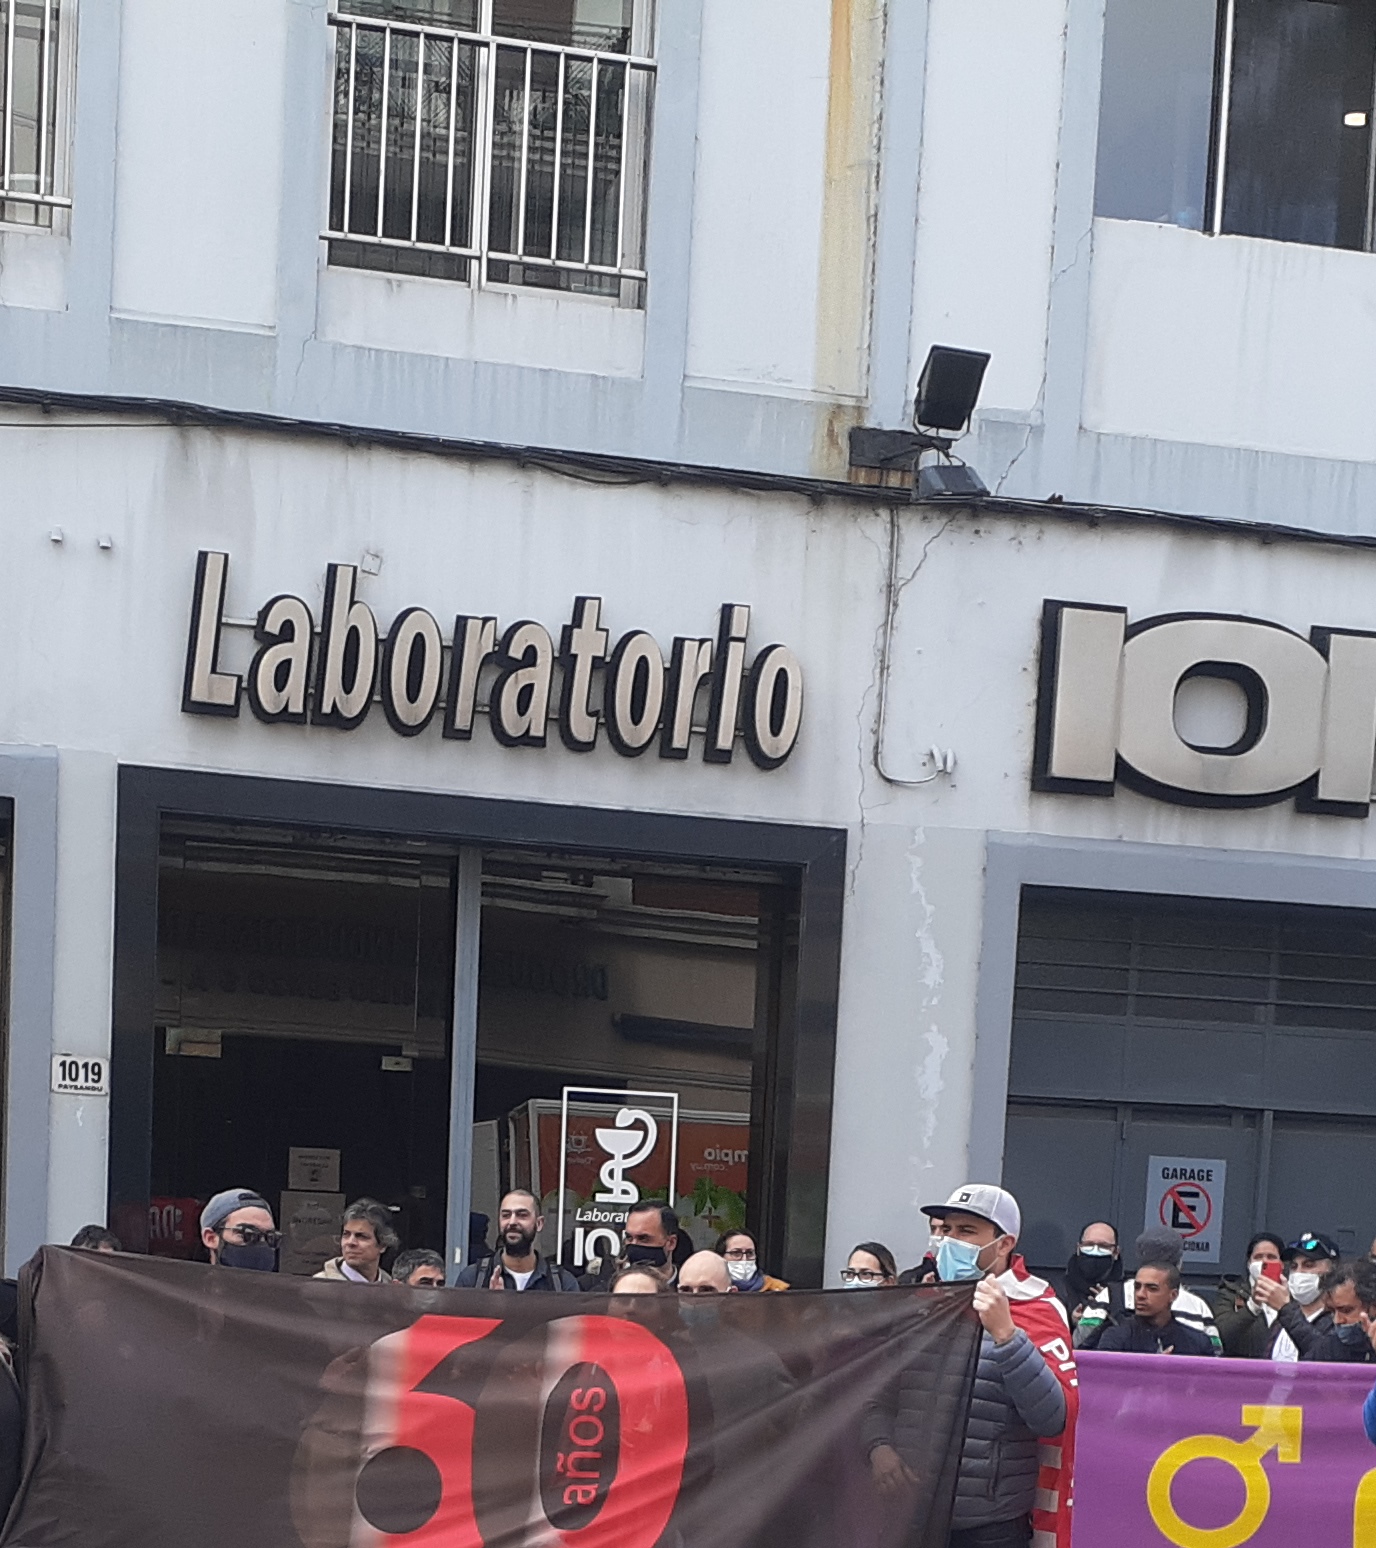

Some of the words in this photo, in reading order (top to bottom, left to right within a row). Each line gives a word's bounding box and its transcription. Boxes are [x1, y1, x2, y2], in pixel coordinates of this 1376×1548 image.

[181, 549, 804, 770] Laboratorio
[59, 1060, 103, 1083] 1019
[1161, 1167, 1214, 1182] GARAGE
[575, 1207, 630, 1223] Laborat
[574, 1227, 627, 1267] IO
[556, 1385, 607, 1507] años
